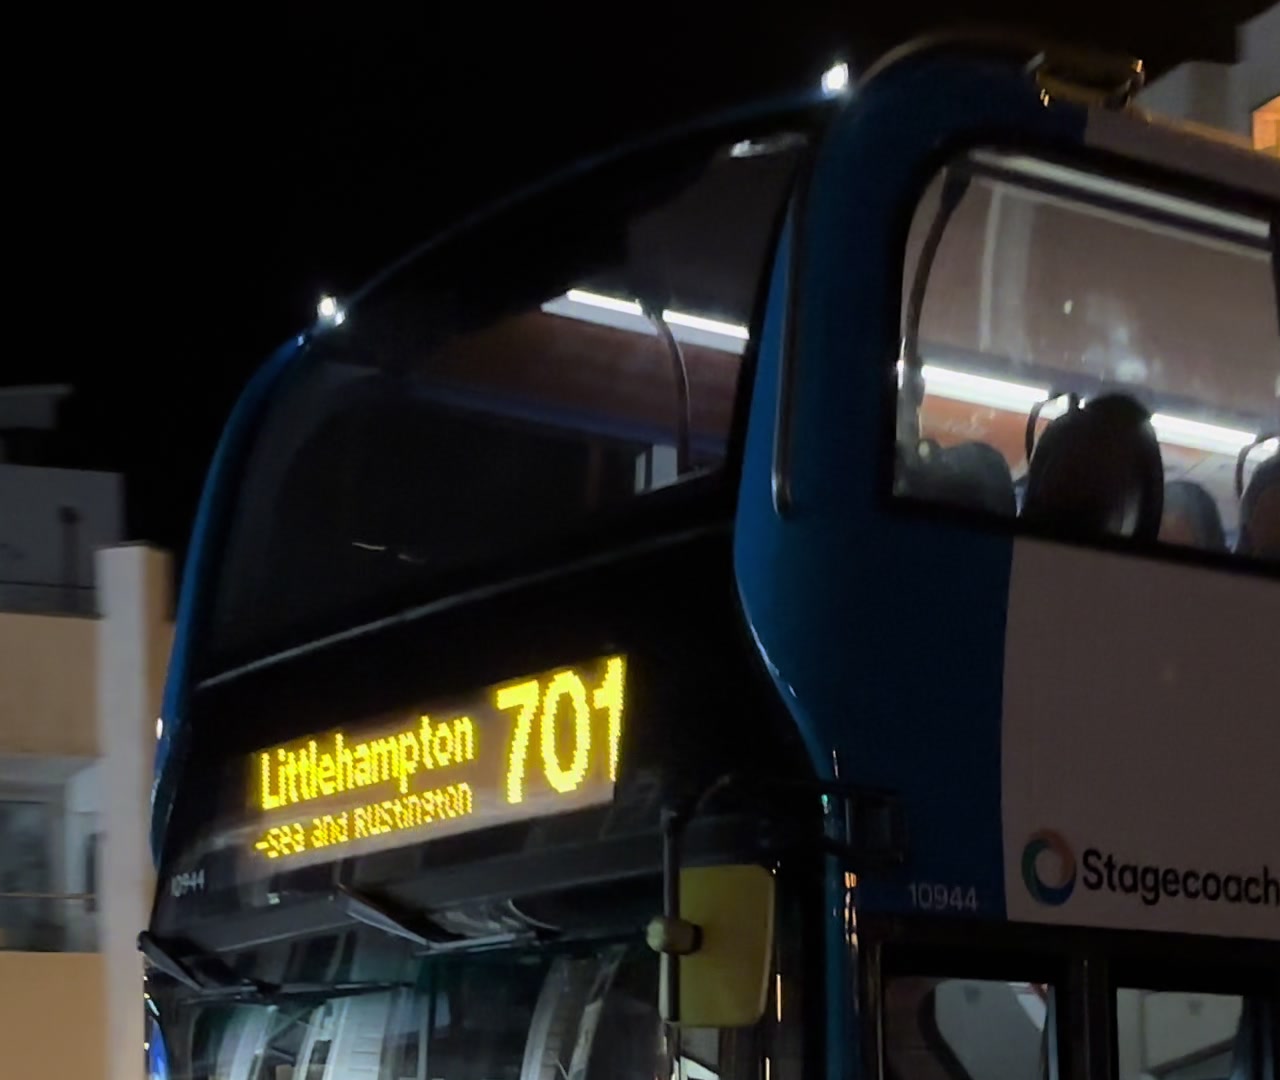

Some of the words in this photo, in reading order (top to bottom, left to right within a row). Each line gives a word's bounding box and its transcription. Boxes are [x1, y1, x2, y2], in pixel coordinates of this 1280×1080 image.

[258, 713, 476, 811] Littlehampton
[496, 655, 627, 805] 701
[310, 811, 349, 849] and
[906, 880, 977, 912] 10944
